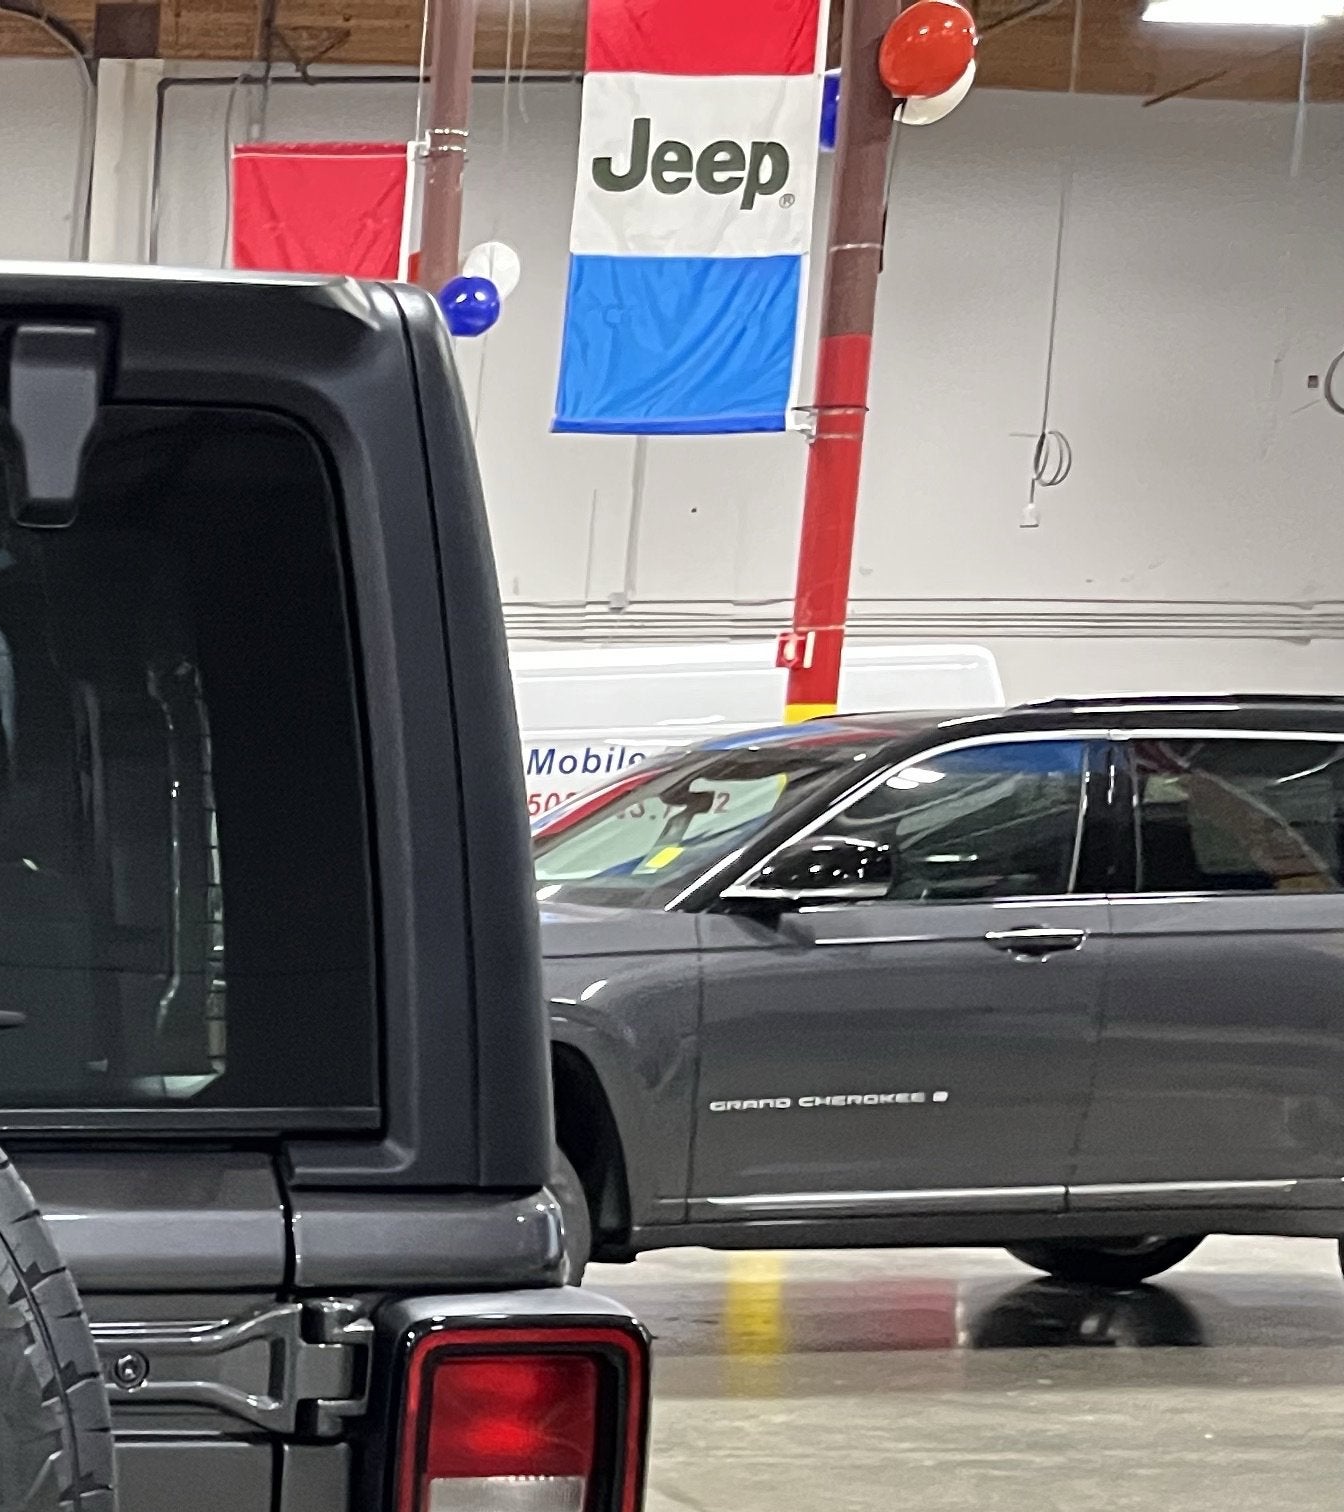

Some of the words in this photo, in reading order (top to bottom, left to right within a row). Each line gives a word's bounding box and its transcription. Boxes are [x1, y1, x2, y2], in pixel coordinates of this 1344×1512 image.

[592, 117, 790, 210] Jeep
[710, 1097, 791, 1112] GRAND
[798, 1092, 926, 1107] CHEROKEE
